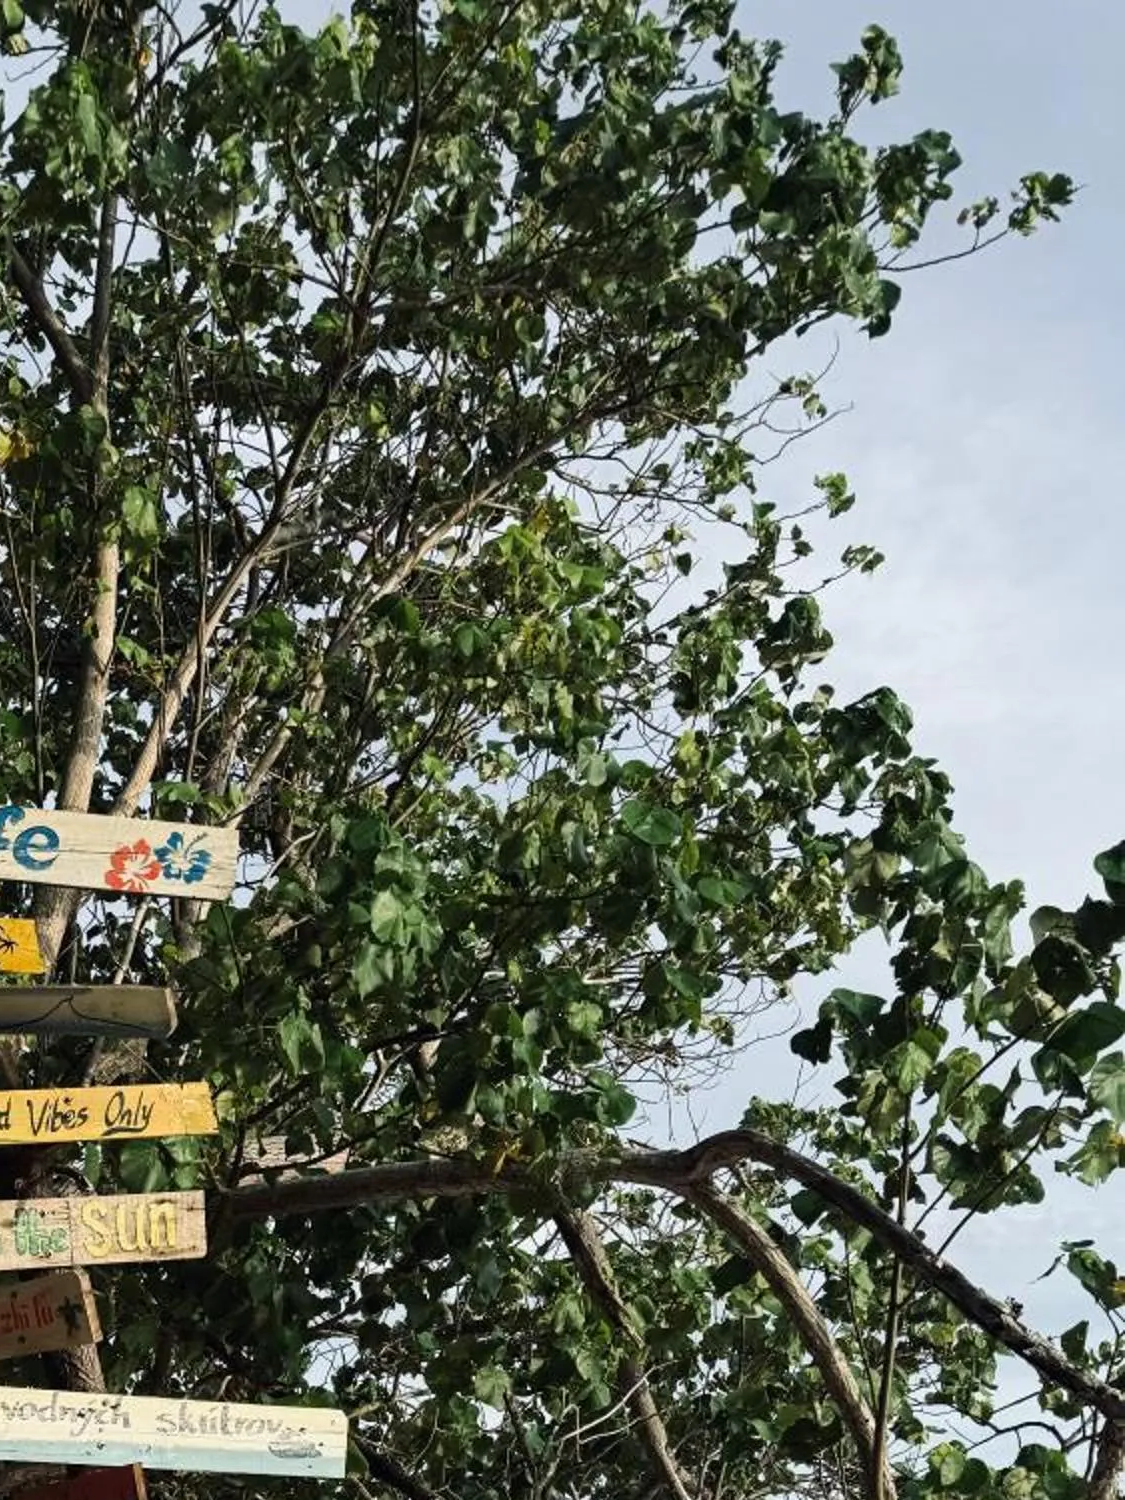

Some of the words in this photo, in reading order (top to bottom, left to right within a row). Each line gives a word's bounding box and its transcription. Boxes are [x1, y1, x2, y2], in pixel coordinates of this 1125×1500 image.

[26, 1094, 90, 1137] Vibes
[101, 1090, 156, 1137] Only
[14, 1206, 69, 1257] the
